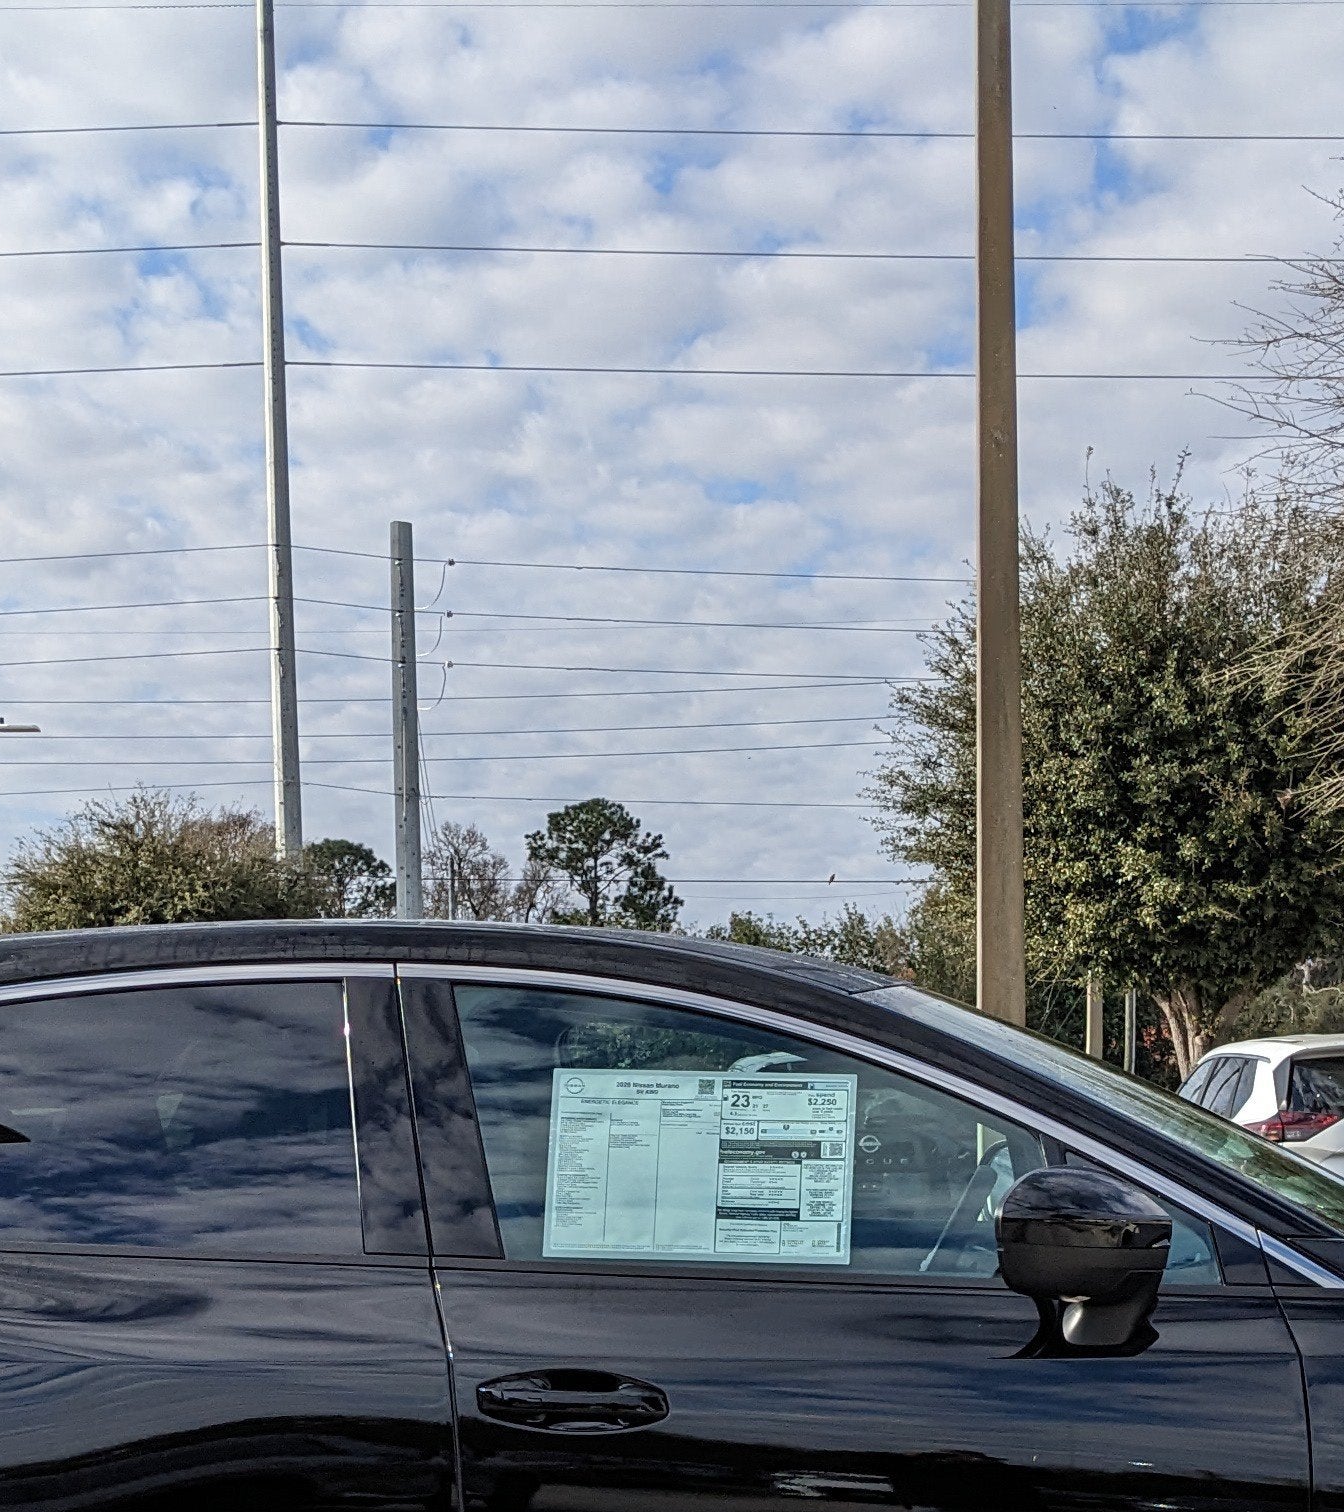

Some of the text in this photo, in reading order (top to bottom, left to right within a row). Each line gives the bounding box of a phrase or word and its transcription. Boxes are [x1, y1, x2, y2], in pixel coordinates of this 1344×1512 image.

[730, 1094, 751, 1108] 23
[808, 1098, 837, 1106] $2,250
[725, 1126, 755, 1136] $2,150
